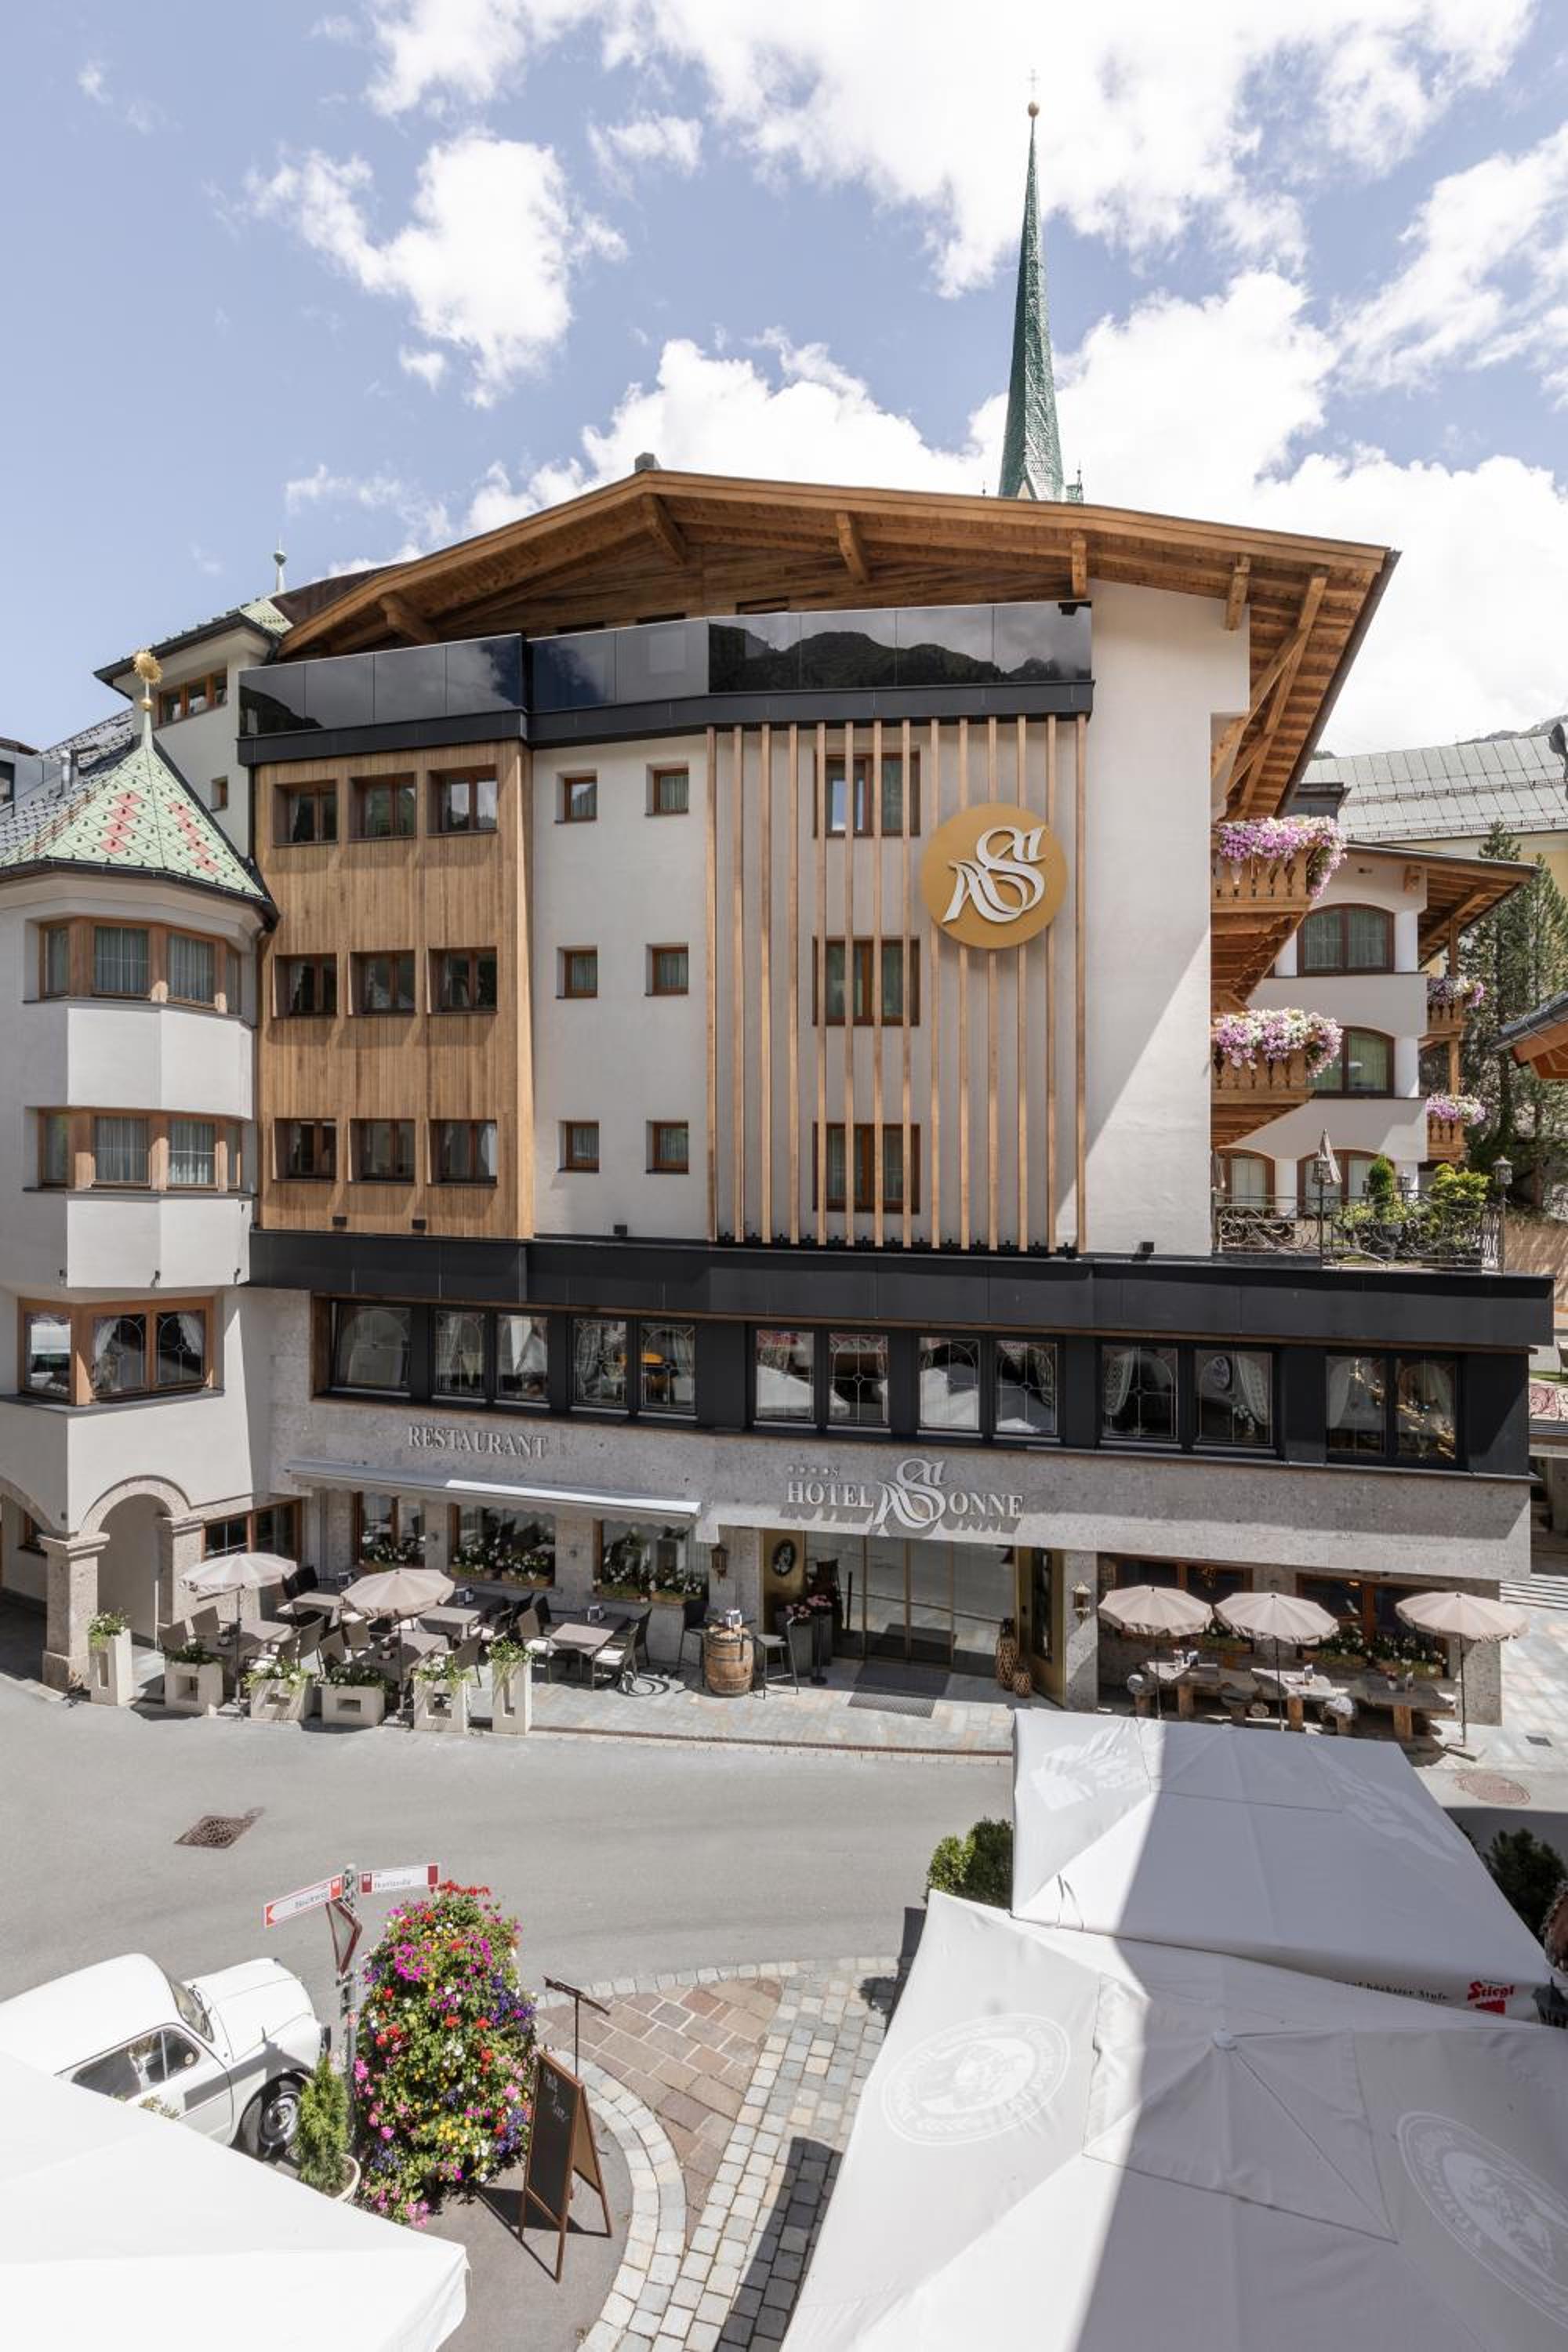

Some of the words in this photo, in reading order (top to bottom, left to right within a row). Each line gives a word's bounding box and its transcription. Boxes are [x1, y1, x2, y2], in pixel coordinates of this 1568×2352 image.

[408, 1425, 547, 1459] RESTAURANT
[787, 1481, 874, 1508] HOTEL
[1468, 1980, 1515, 2001] Stiegl
